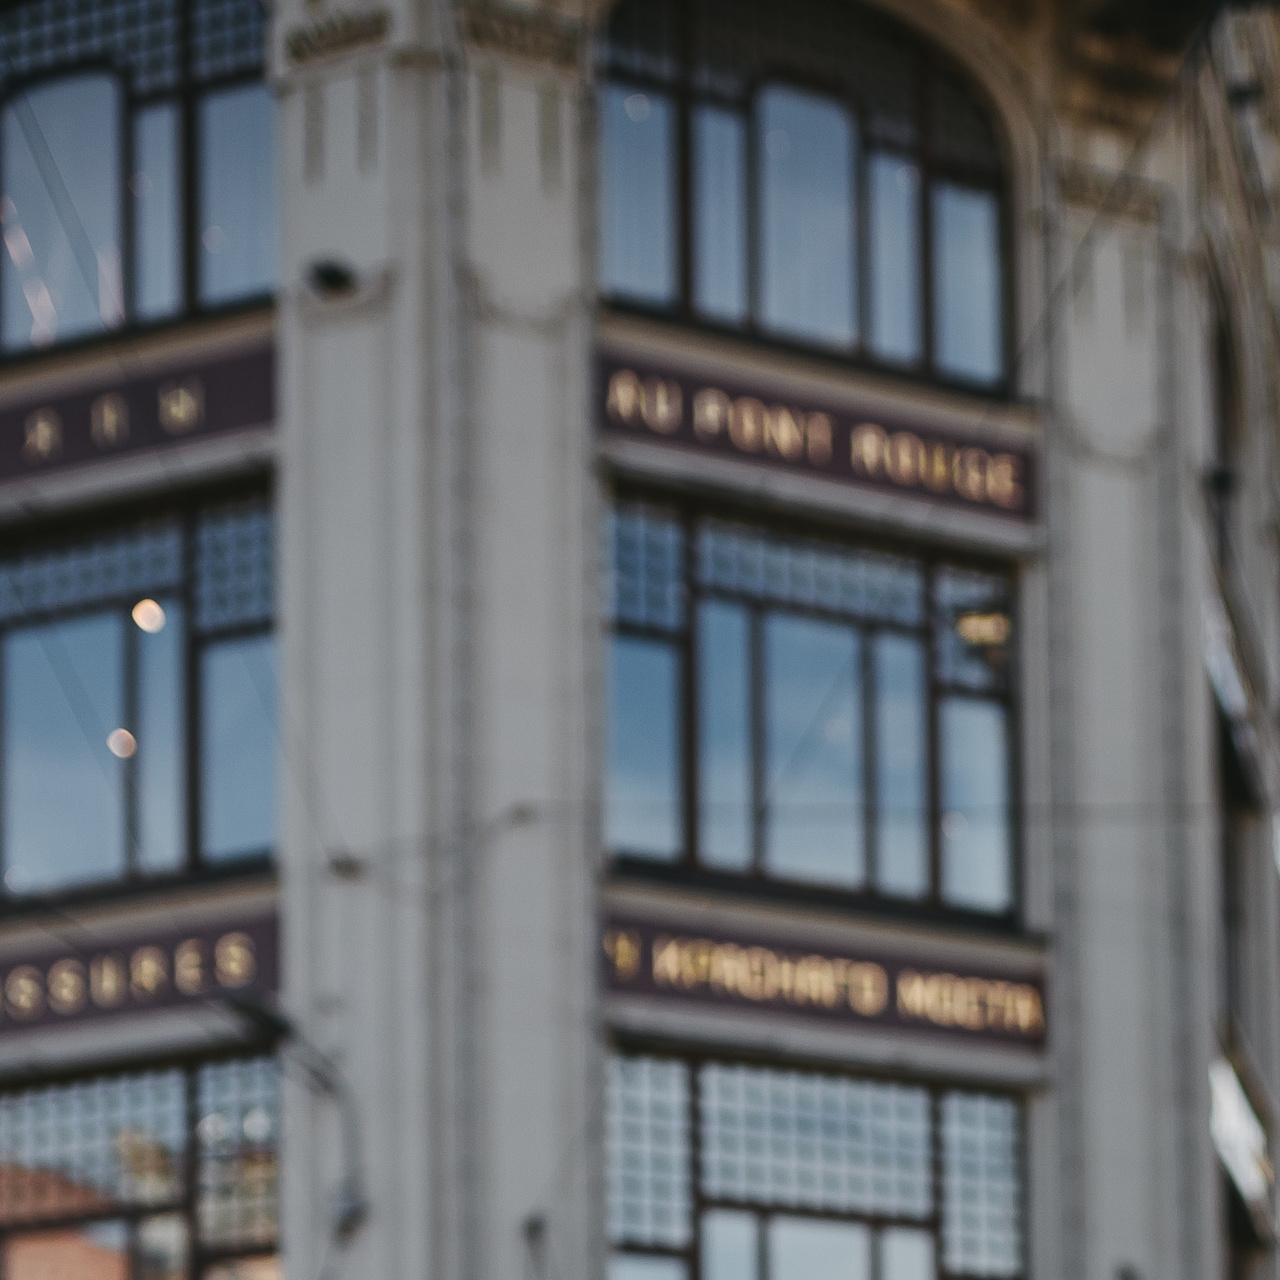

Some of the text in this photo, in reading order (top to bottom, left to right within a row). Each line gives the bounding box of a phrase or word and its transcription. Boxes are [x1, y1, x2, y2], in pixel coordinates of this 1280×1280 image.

[607, 369, 1026, 509] AU PONT ROUGE
